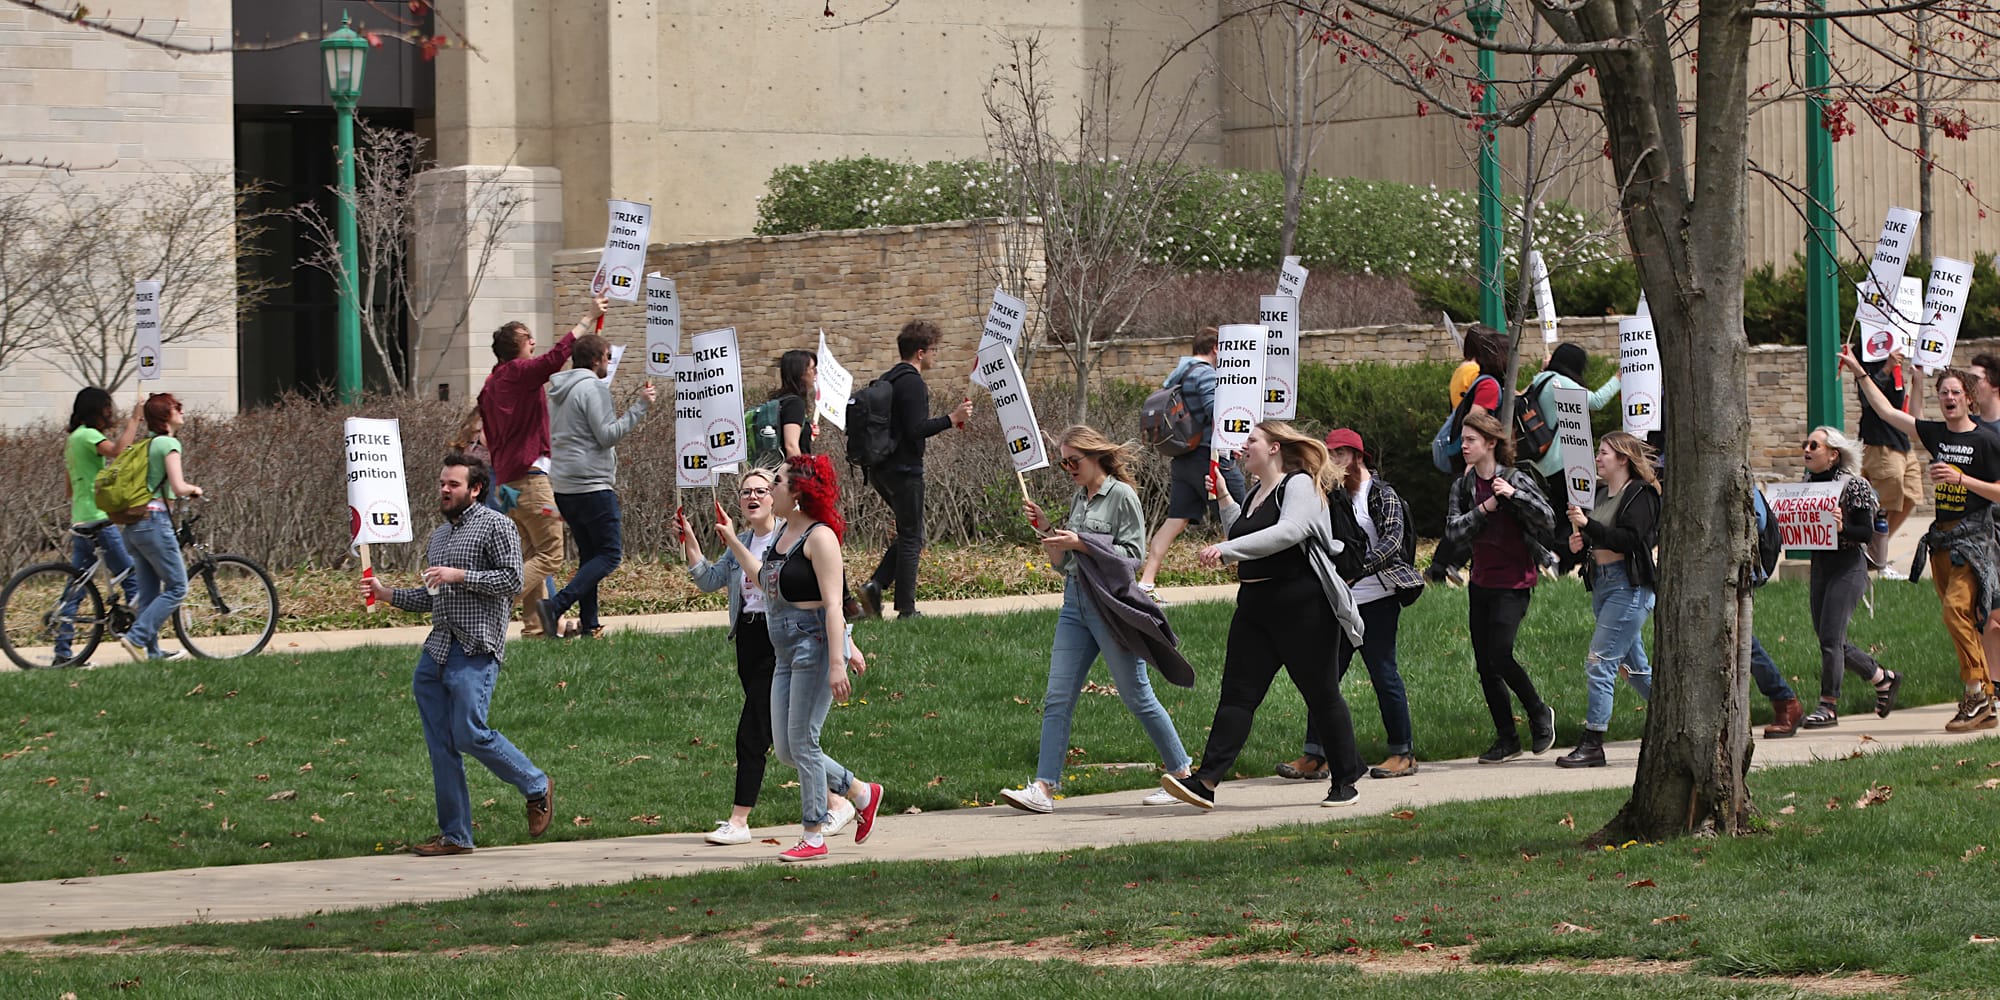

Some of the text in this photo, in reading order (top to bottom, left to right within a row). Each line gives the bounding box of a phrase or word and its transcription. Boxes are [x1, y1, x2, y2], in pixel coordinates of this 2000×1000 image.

[612, 211, 644, 225] TRIKE
[612, 274, 632, 288] UE
[1281, 270, 1299, 286] RIKE
[1931, 270, 1963, 285] RIKE
[648, 288, 671, 299] RIKE
[1219, 340, 1257, 352] TRIKE
[1920, 338, 1944, 354] UE
[652, 352, 670, 364] UE
[693, 346, 728, 363] RIKE
[697, 366, 725, 381] nion
[1620, 362, 1654, 375] nition
[1556, 401, 1582, 414] RIKE
[1628, 403, 1650, 417] UE
[1223, 419, 1250, 433] UE
[1559, 418, 1581, 431] nion
[710, 430, 736, 449] UE
[1008, 436, 1031, 455] UE
[1560, 434, 1588, 447] nition
[349, 451, 388, 462] Union
[683, 455, 707, 469] UE
[1572, 477, 1590, 493] UE
[371, 512, 399, 526] UE
[1777, 511, 1821, 523] ANT TO BE
[1803, 524, 1833, 546] MADE
